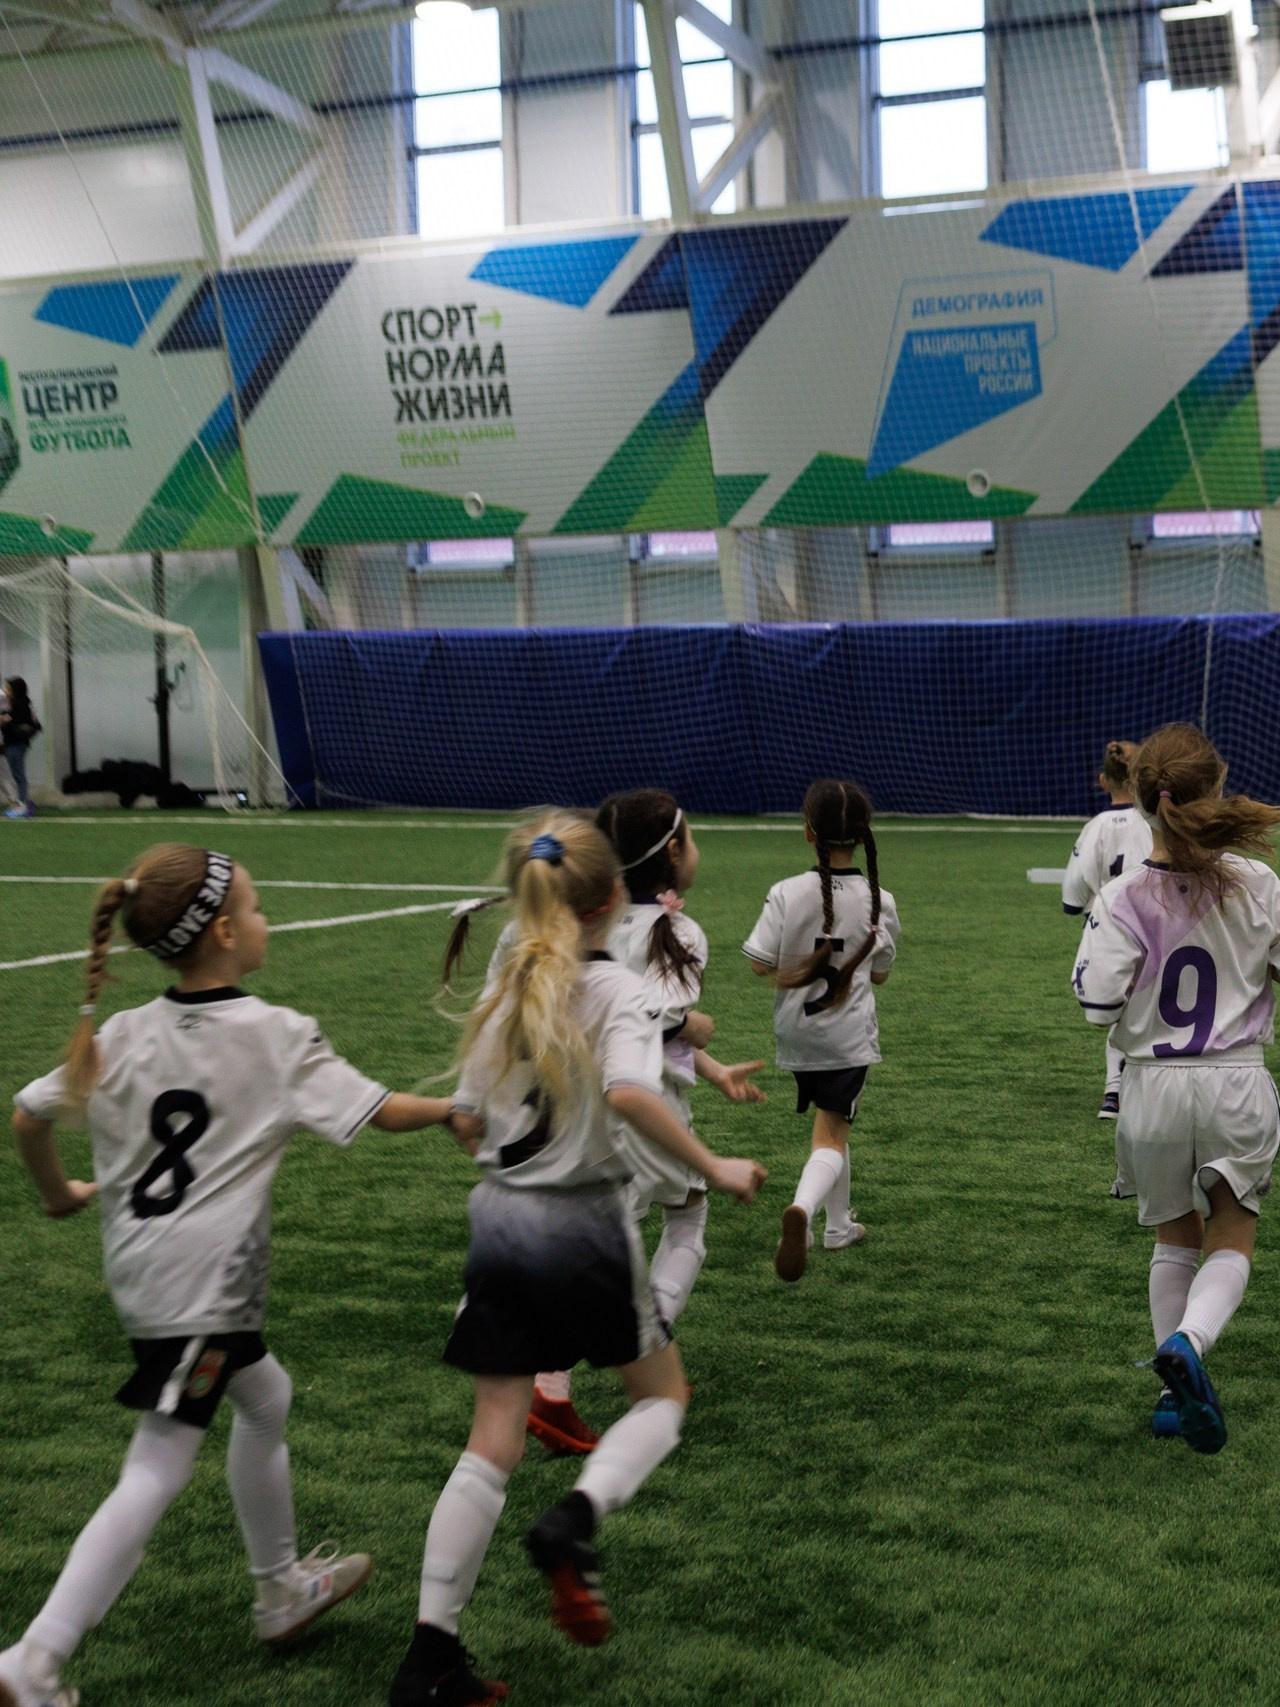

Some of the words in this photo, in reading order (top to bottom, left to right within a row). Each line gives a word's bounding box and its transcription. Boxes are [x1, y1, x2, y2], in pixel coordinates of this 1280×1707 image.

[911, 288, 1044, 319] ДЕМОГРАФИЯ
[381, 303, 477, 343] СПОРТ
[911, 326, 1029, 357] НАЦИОНАЛЬНЫЕ
[385, 342, 506, 384] НОРМА
[963, 350, 1031, 374] ПРОЕКТЫ
[22, 380, 119, 421] ЦЕНТР
[978, 371, 1034, 395] РОССИИ
[391, 381, 512, 424] ЖИЗНИ
[28, 427, 132, 453] ФУТБОЛА
[400, 450, 461, 468] ПРОЕКТ
[1152, 945, 1217, 1058] 9
[130, 1089, 210, 1219] 8
